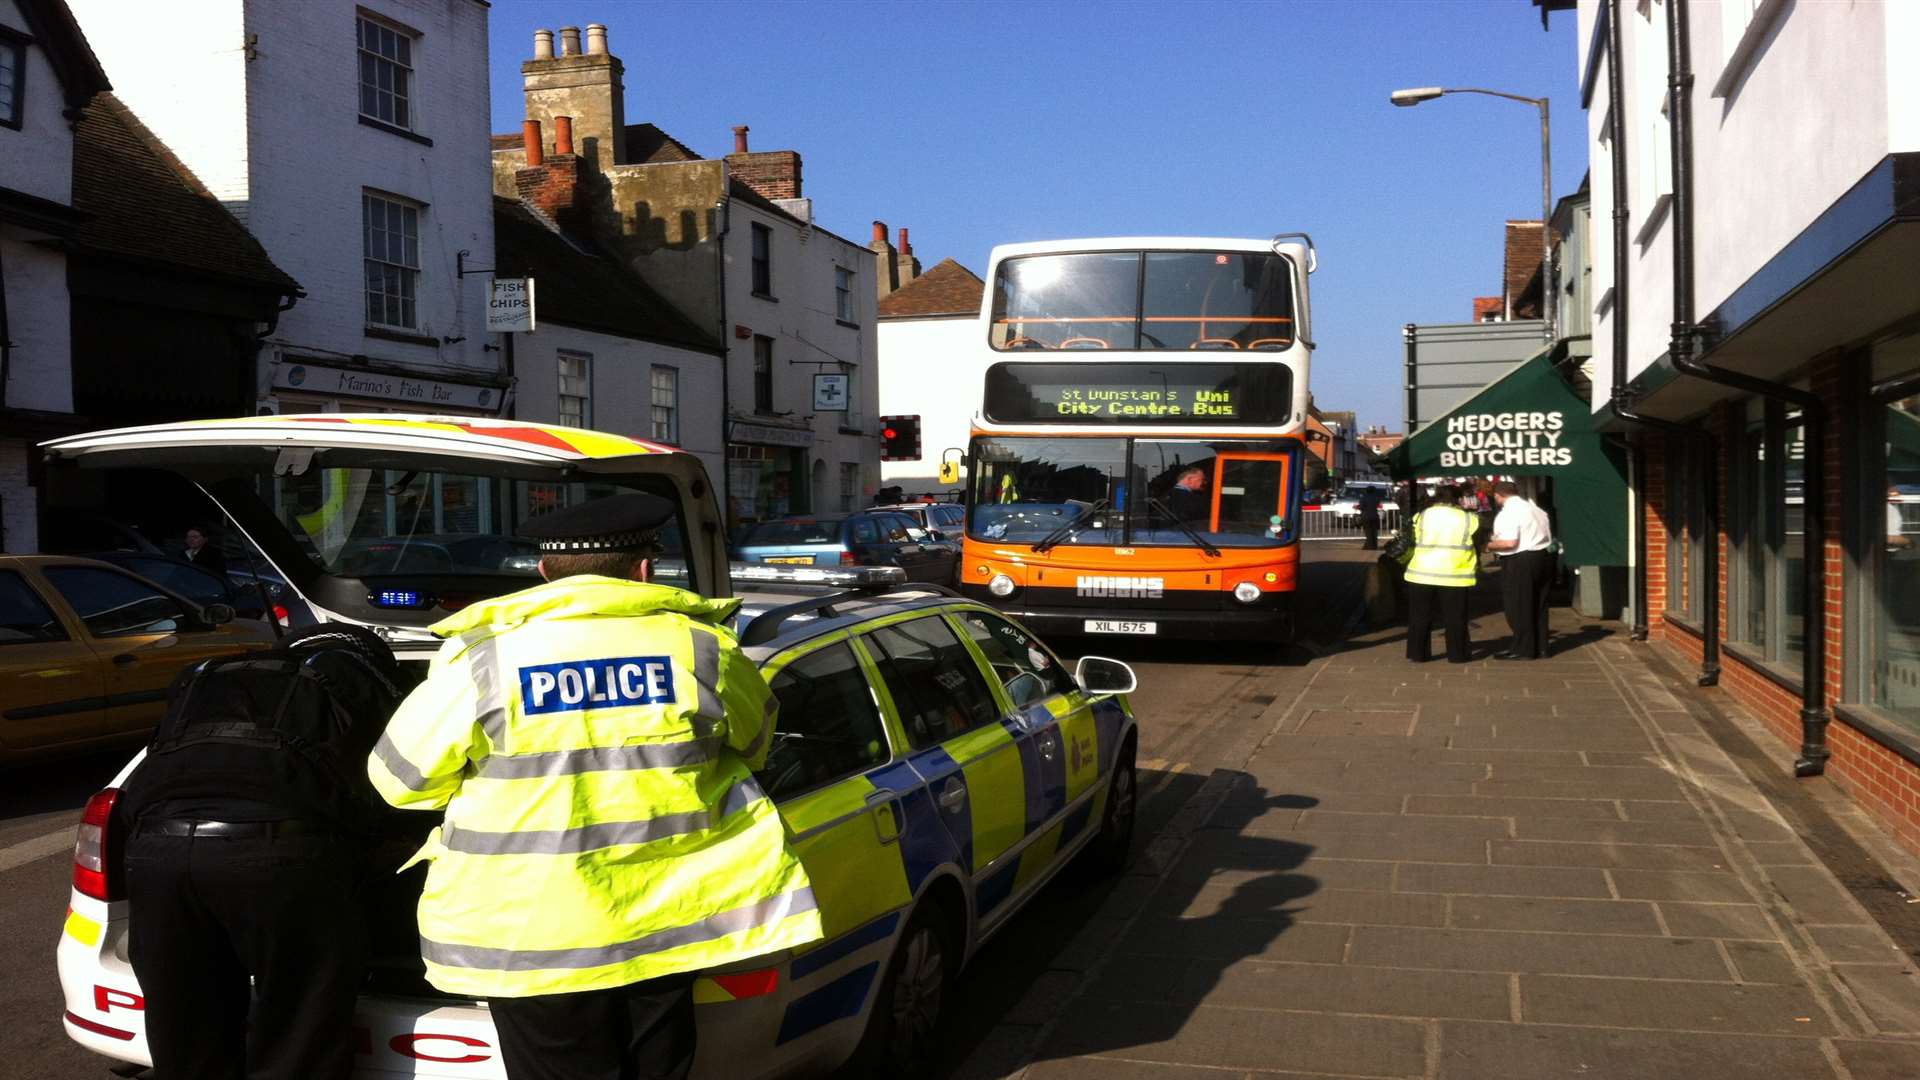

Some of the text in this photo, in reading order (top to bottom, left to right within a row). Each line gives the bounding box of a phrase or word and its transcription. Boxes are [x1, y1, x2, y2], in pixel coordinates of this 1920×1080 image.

[494, 283, 526, 292] FISH
[490, 299, 530, 308] CHIPS
[338, 372, 453, 401] Marino's Fish Bar
[1062, 389, 1229, 402] St Dunstans Uni
[1057, 402, 1233, 415] City Centre Bus
[1447, 412, 1564, 433] HEDGERS
[1446, 430, 1562, 451] QUALITY
[1440, 448, 1572, 467] BUTCHERS
[1095, 621, 1147, 633] XIL 1575
[530, 663, 668, 707] POLICE
